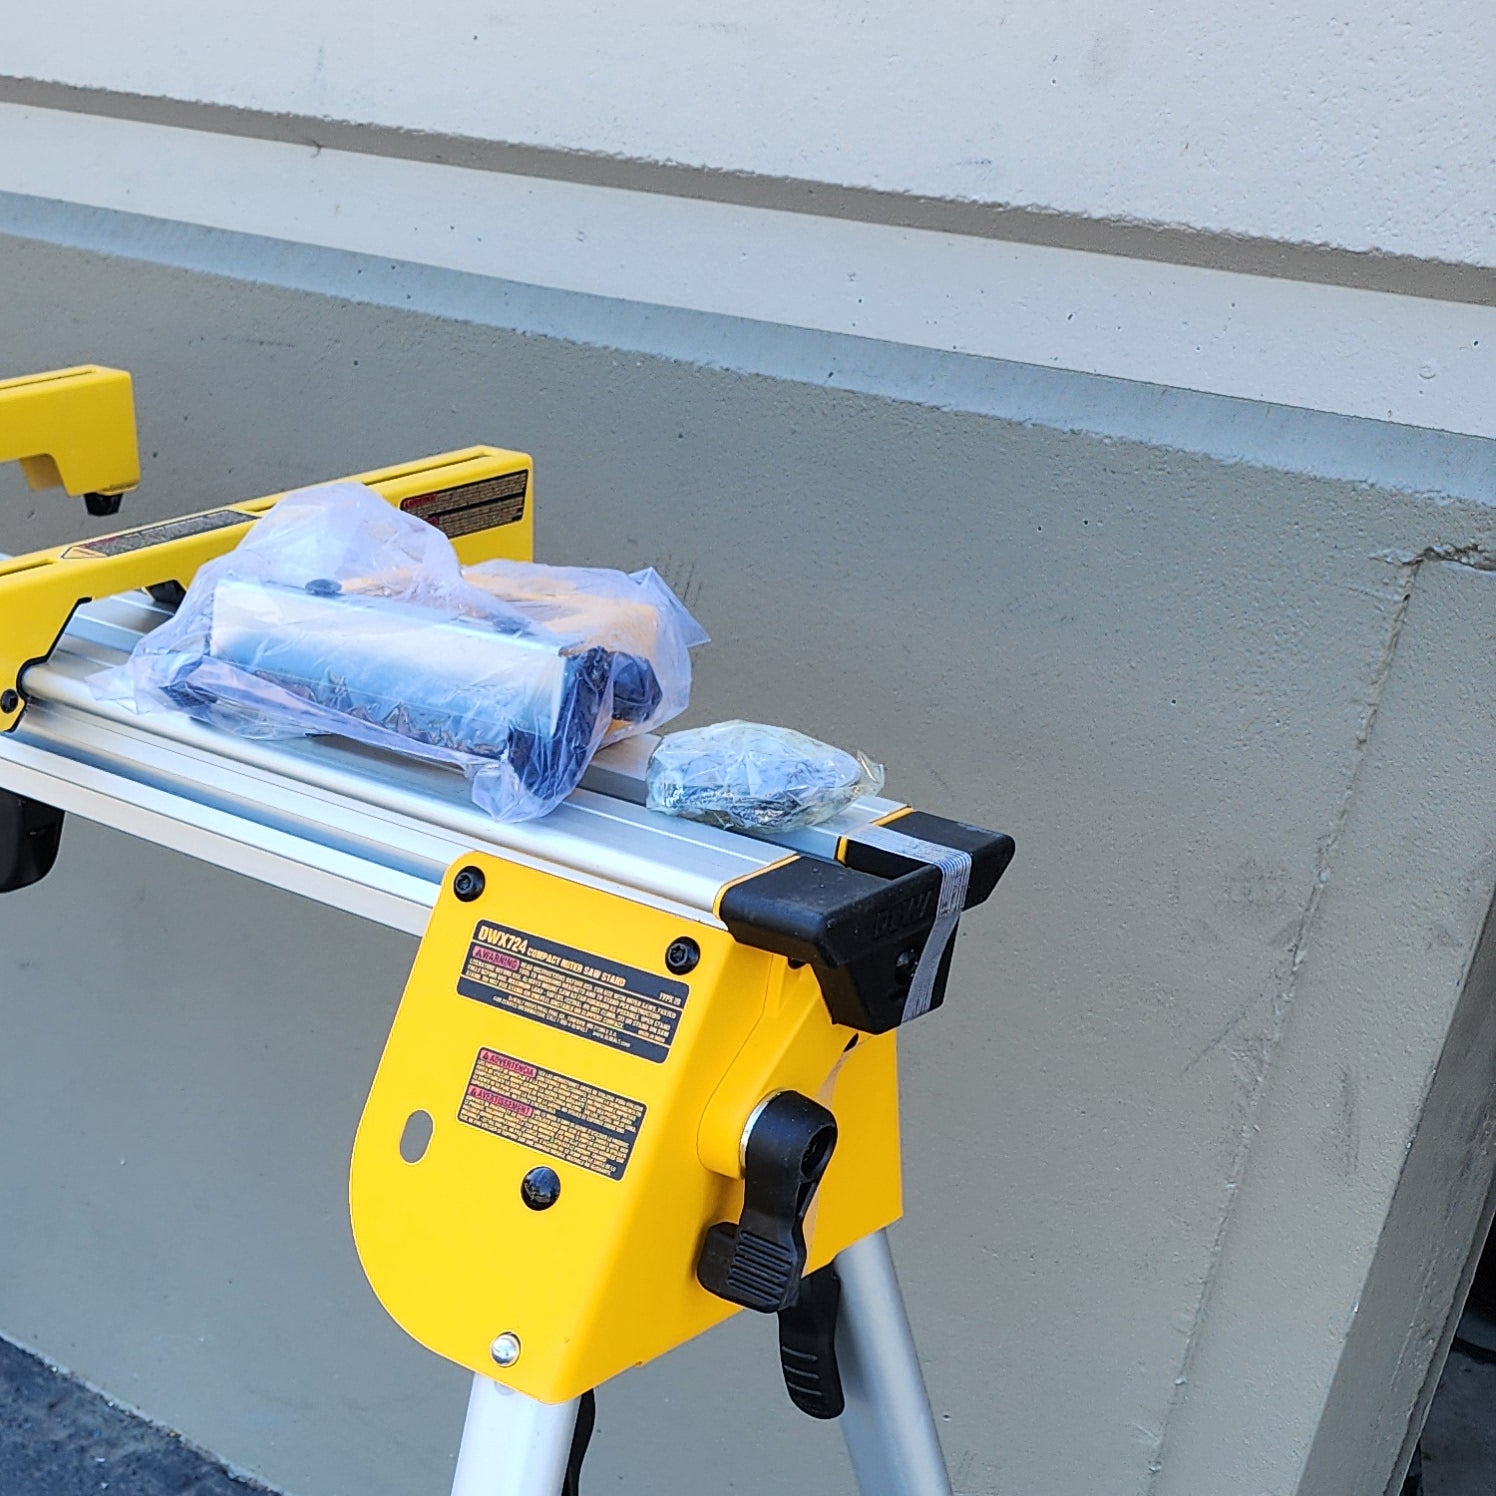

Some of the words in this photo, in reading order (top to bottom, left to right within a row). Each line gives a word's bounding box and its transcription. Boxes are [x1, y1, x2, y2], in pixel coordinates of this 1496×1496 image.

[478, 925, 529, 954] DWX724
[527, 947, 562, 965] COMPACT
[583, 966, 602, 979] SAW
[601, 972, 626, 987] STAND
[482, 949, 518, 969] WARNING
[489, 1054, 534, 1077] ADVERTENCIA
[477, 1091, 531, 1116] AVERTISSEMENT
